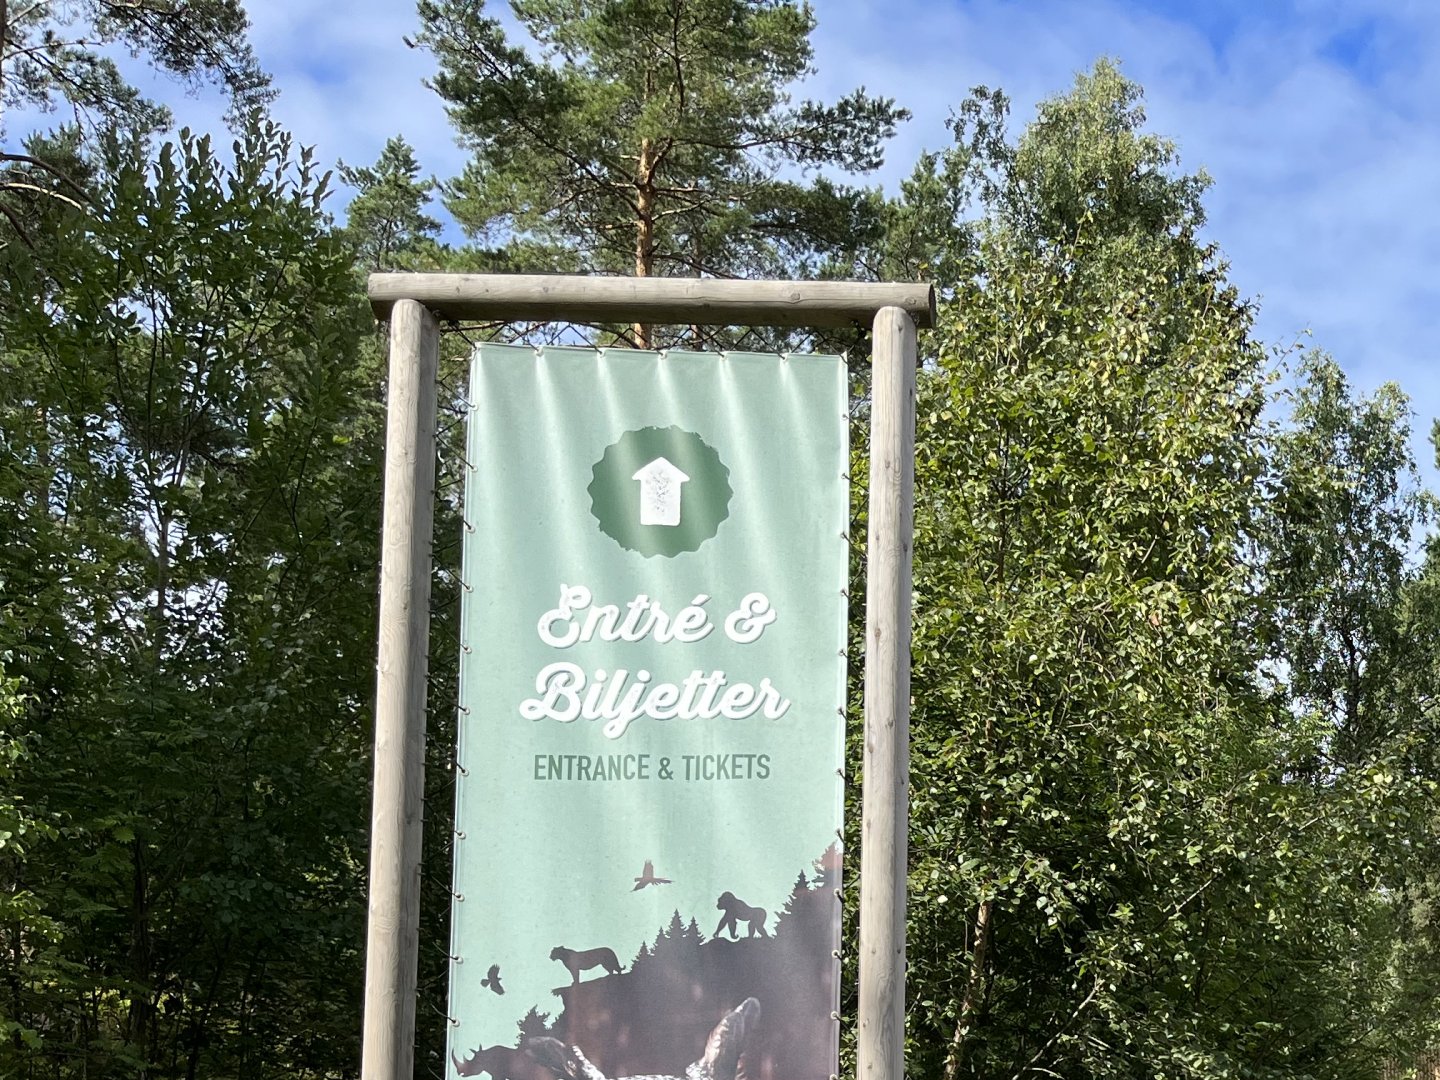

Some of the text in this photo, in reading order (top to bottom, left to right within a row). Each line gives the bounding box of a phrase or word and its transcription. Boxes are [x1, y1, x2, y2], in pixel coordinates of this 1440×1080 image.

[536, 583, 777, 649] Entré &
[519, 661, 792, 740] Biljetter
[534, 753, 771, 781] ENTRANCE & TICKETS
